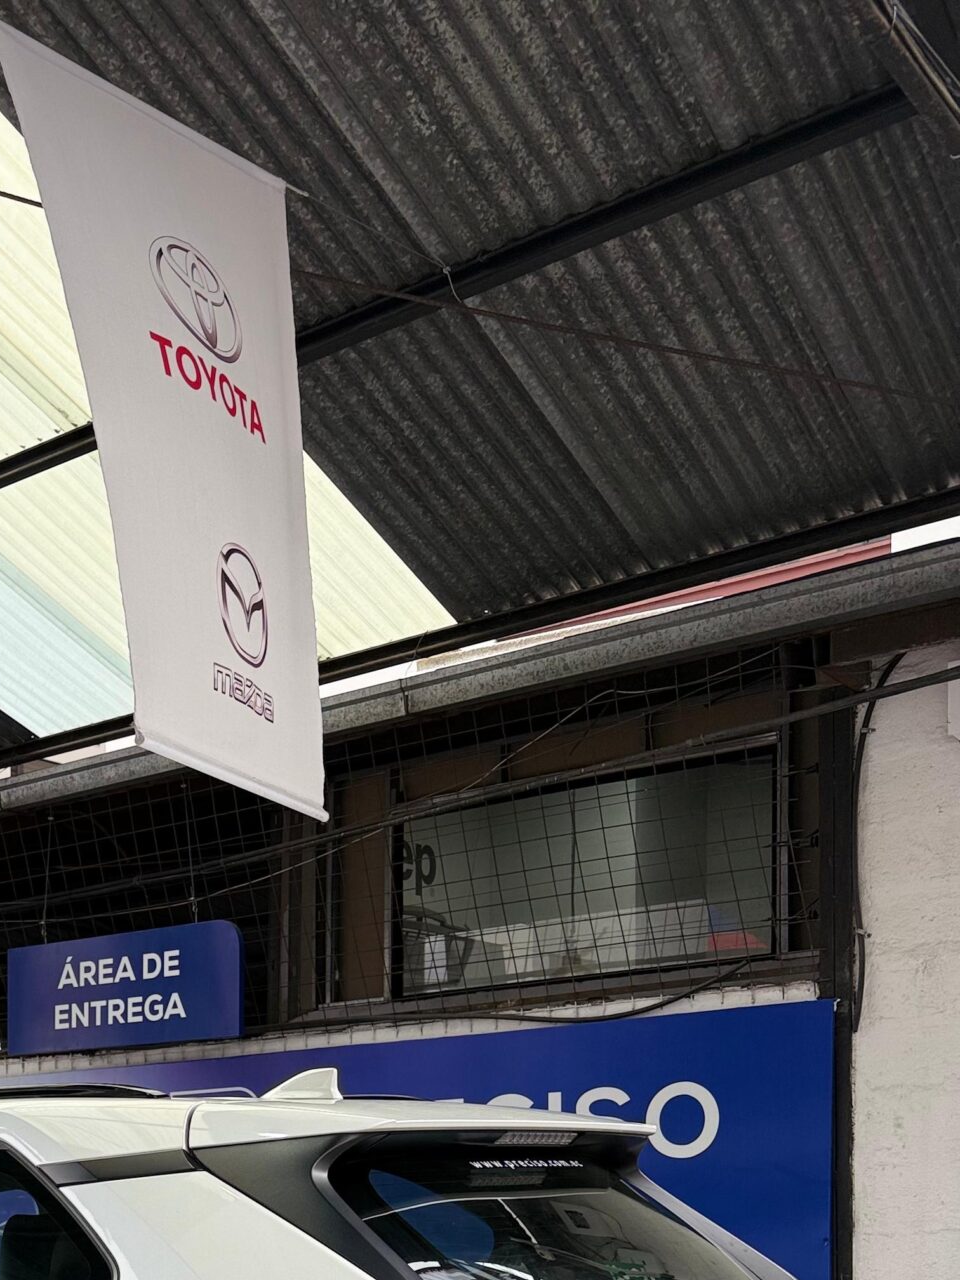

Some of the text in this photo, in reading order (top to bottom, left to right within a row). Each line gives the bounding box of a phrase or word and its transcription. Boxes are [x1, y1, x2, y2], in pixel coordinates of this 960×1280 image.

[149, 331, 267, 445] TOYOTA
[57, 949, 180, 990] ÁREA DE
[54, 992, 187, 1030] ENTREGA
